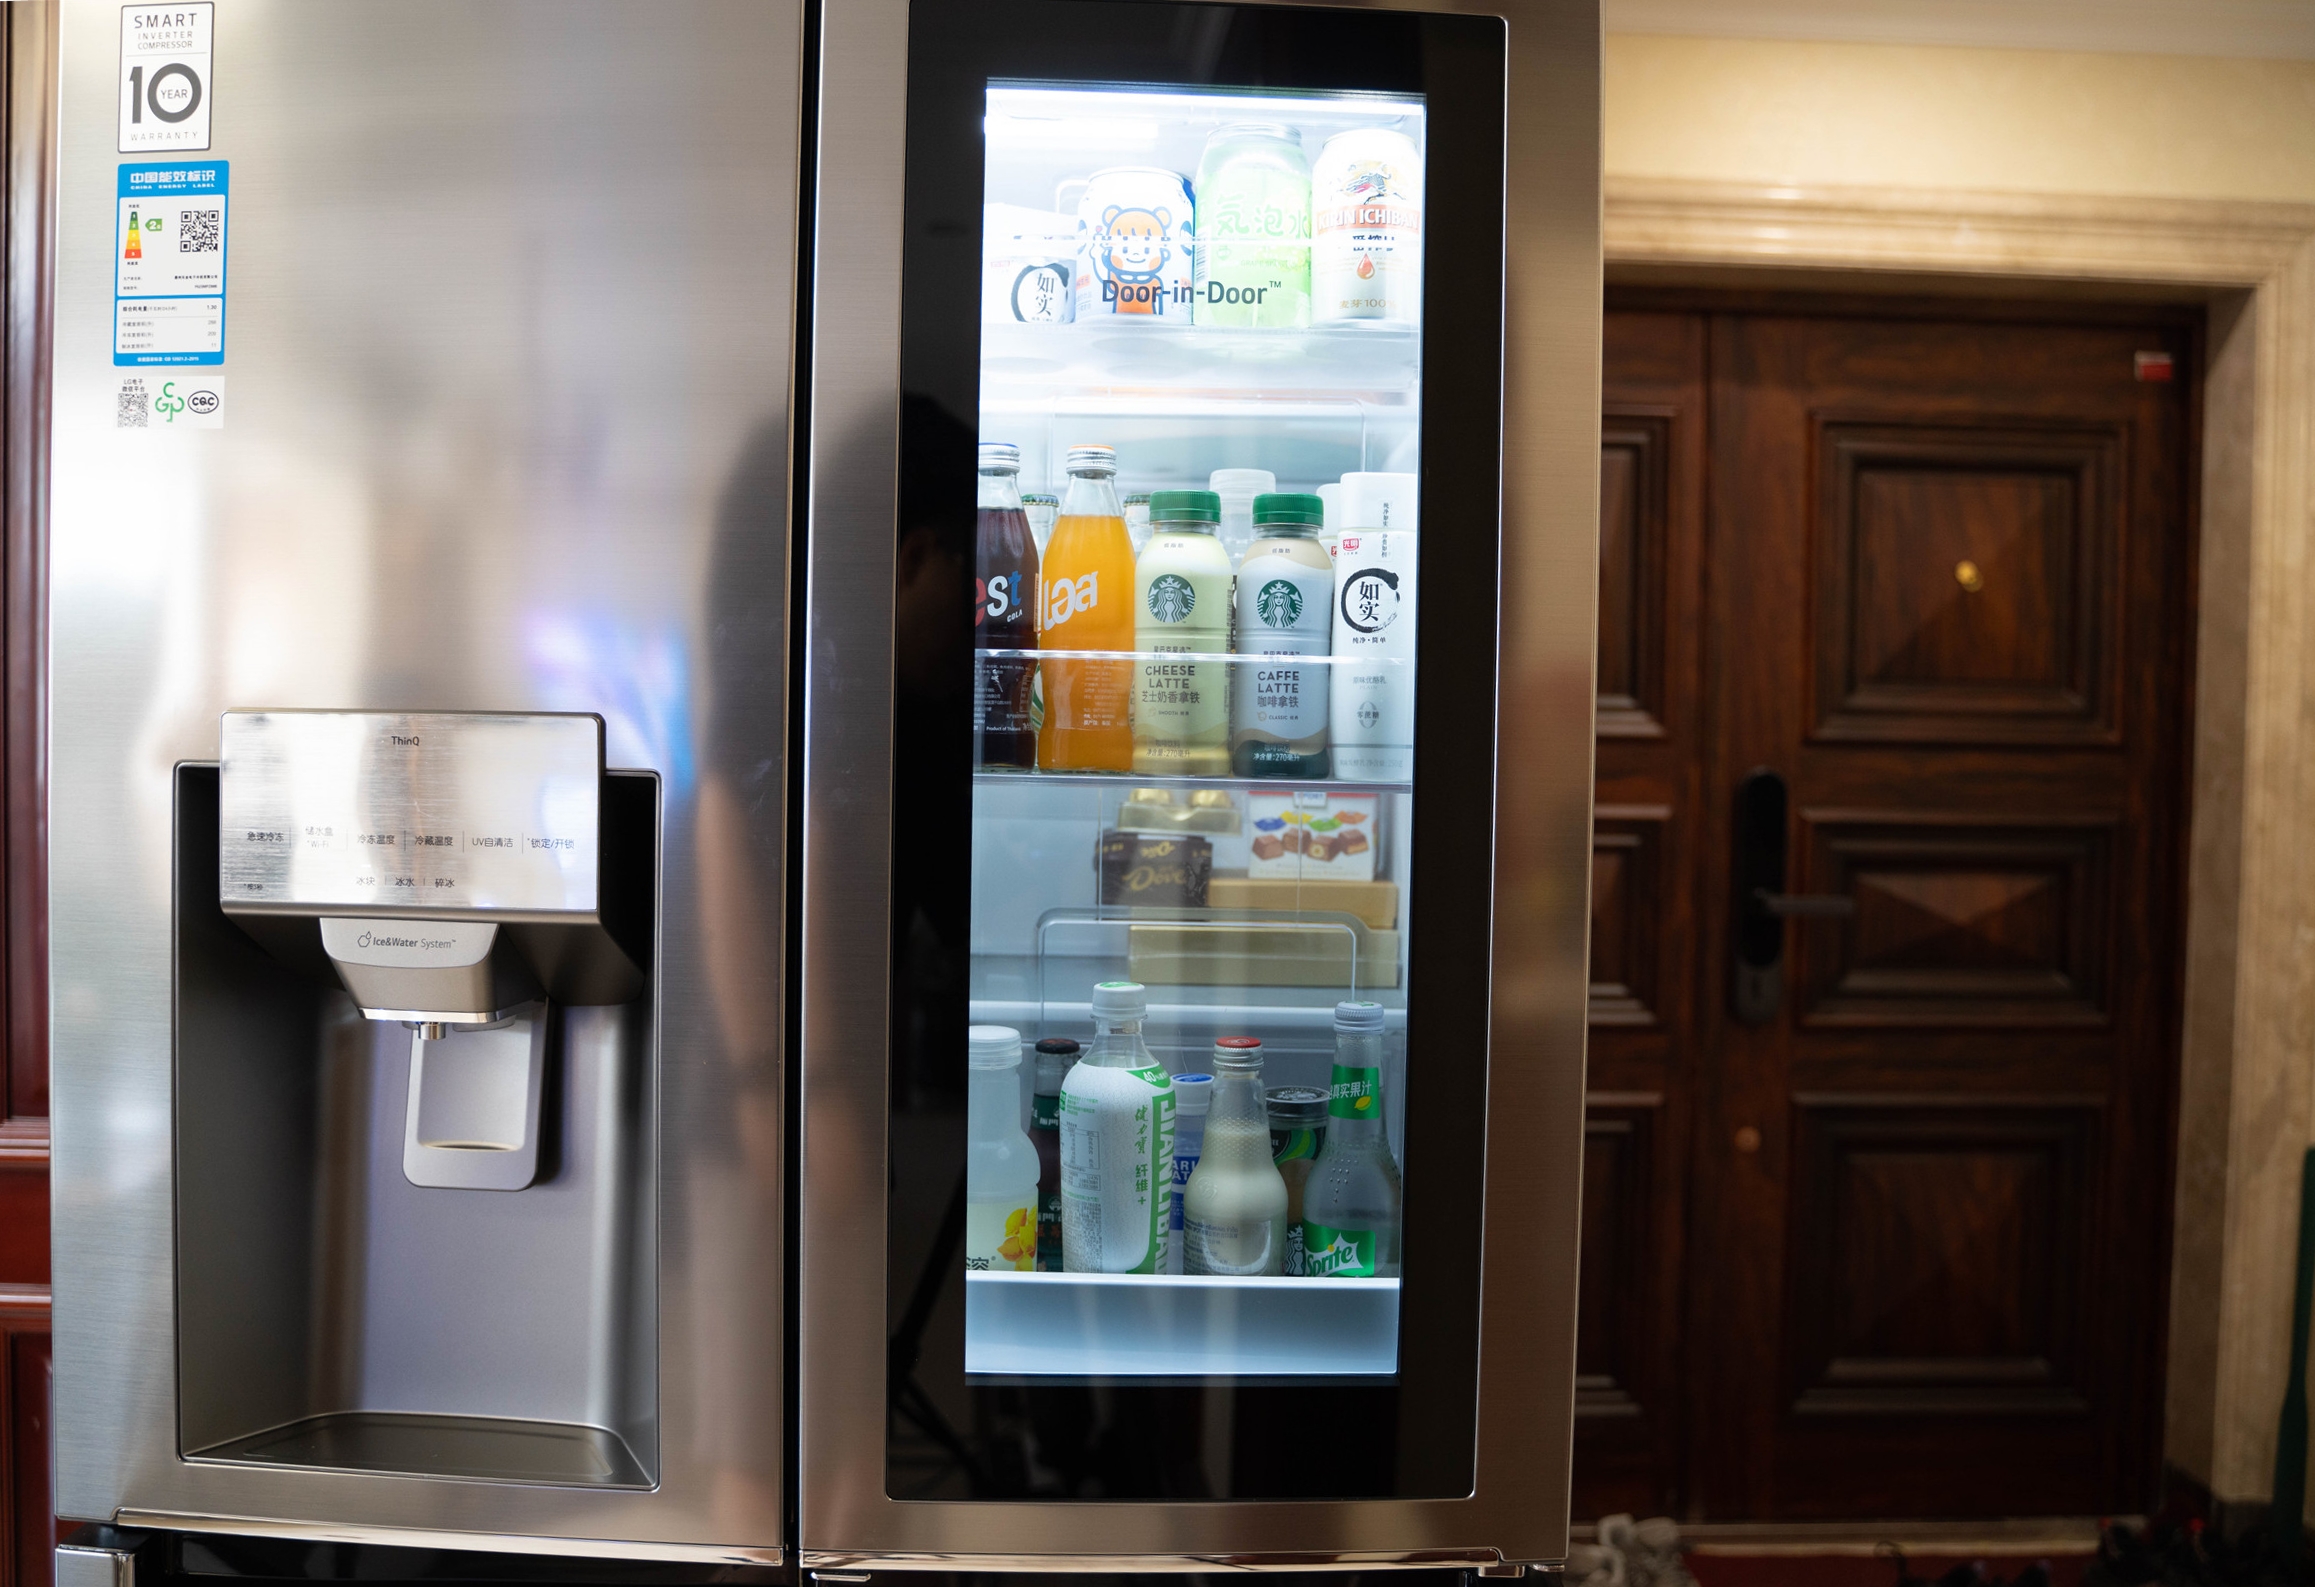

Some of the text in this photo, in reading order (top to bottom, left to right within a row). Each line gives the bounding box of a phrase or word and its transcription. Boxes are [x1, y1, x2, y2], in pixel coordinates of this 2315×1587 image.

[134, 13, 197, 29] SMART
[138, 31, 193, 40] INVERTER
[138, 41, 193, 50] COMPRESSOR
[129, 63, 202, 124] 10
[161, 89, 188, 99] YEAR
[131, 132, 198, 141] WARRANTY
[130, 170, 216, 184] 中国能效标识
[1318, 208, 1418, 231] KIRIN ICHIBAN
[192, 397, 215, 406] CQC
[1344, 539, 1359, 549] 光明
[1359, 581, 1380, 622] 如实
[1006, 609, 1023, 623] COLA
[1145, 665, 1196, 676] CHEESE
[1257, 670, 1300, 681] CAFFE
[1149, 678, 1190, 689] LATTE
[1258, 683, 1299, 694] LATTE
[1141, 690, 1200, 704] 芝士奶香拿铁
[1257, 695, 1299, 708] 咖啡拿铁
[391, 736, 420, 746] ThinQ
[247, 831, 284, 842] 急速冷冻
[357, 834, 396, 845] 冷冻温度
[414, 836, 453, 847] 冷藏温度
[472, 837, 514, 848] UV自清洁
[356, 876, 455, 888] 冰块 冰水 碎冰
[373, 936, 418, 948] Ice&Water
[1306, 1245, 1354, 1277] Sprite
